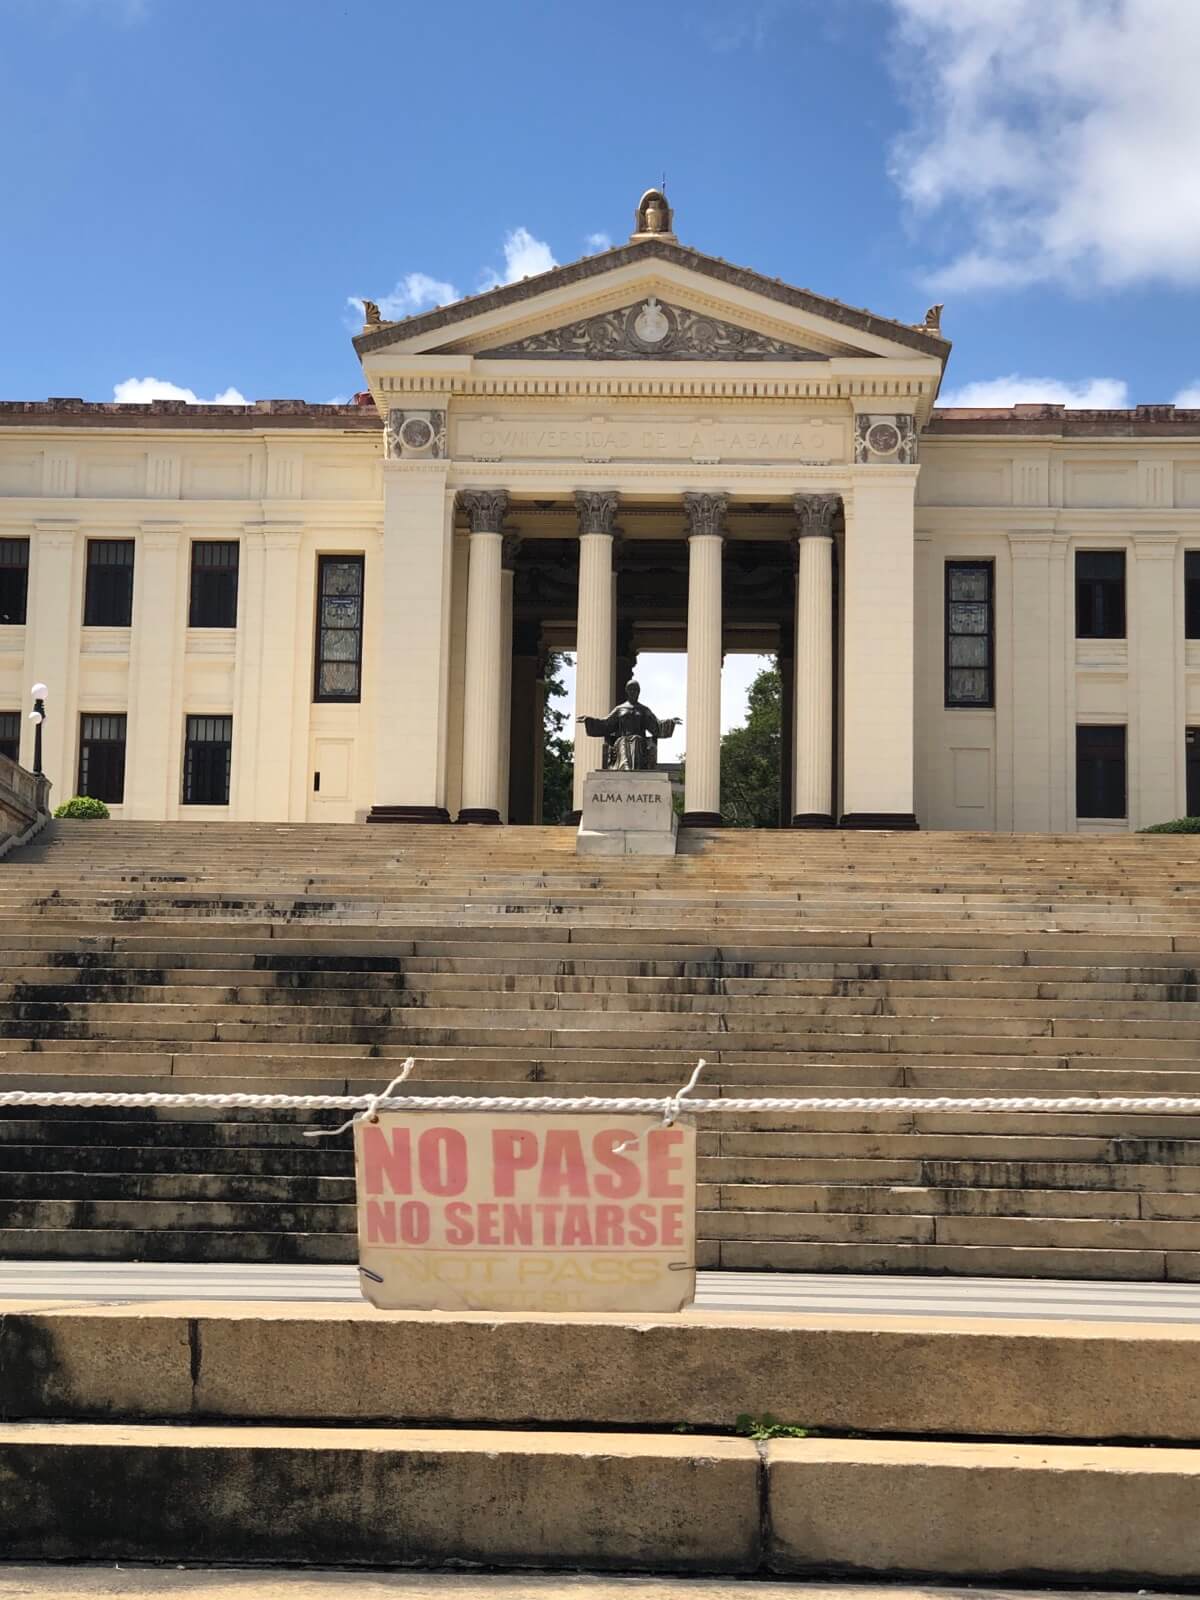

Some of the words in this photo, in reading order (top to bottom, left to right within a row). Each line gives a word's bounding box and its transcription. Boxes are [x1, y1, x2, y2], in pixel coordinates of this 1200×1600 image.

[642, 432, 666, 449] DE
[677, 432, 705, 449] LA
[591, 793, 622, 803] ALMA
[626, 794, 662, 803] MATER
[363, 1127, 468, 1197] NO
[492, 1128, 685, 1199] PASE
[366, 1201, 430, 1246] NO
[445, 1202, 684, 1247] SENTARSE
[518, 1257, 663, 1285] PASS
